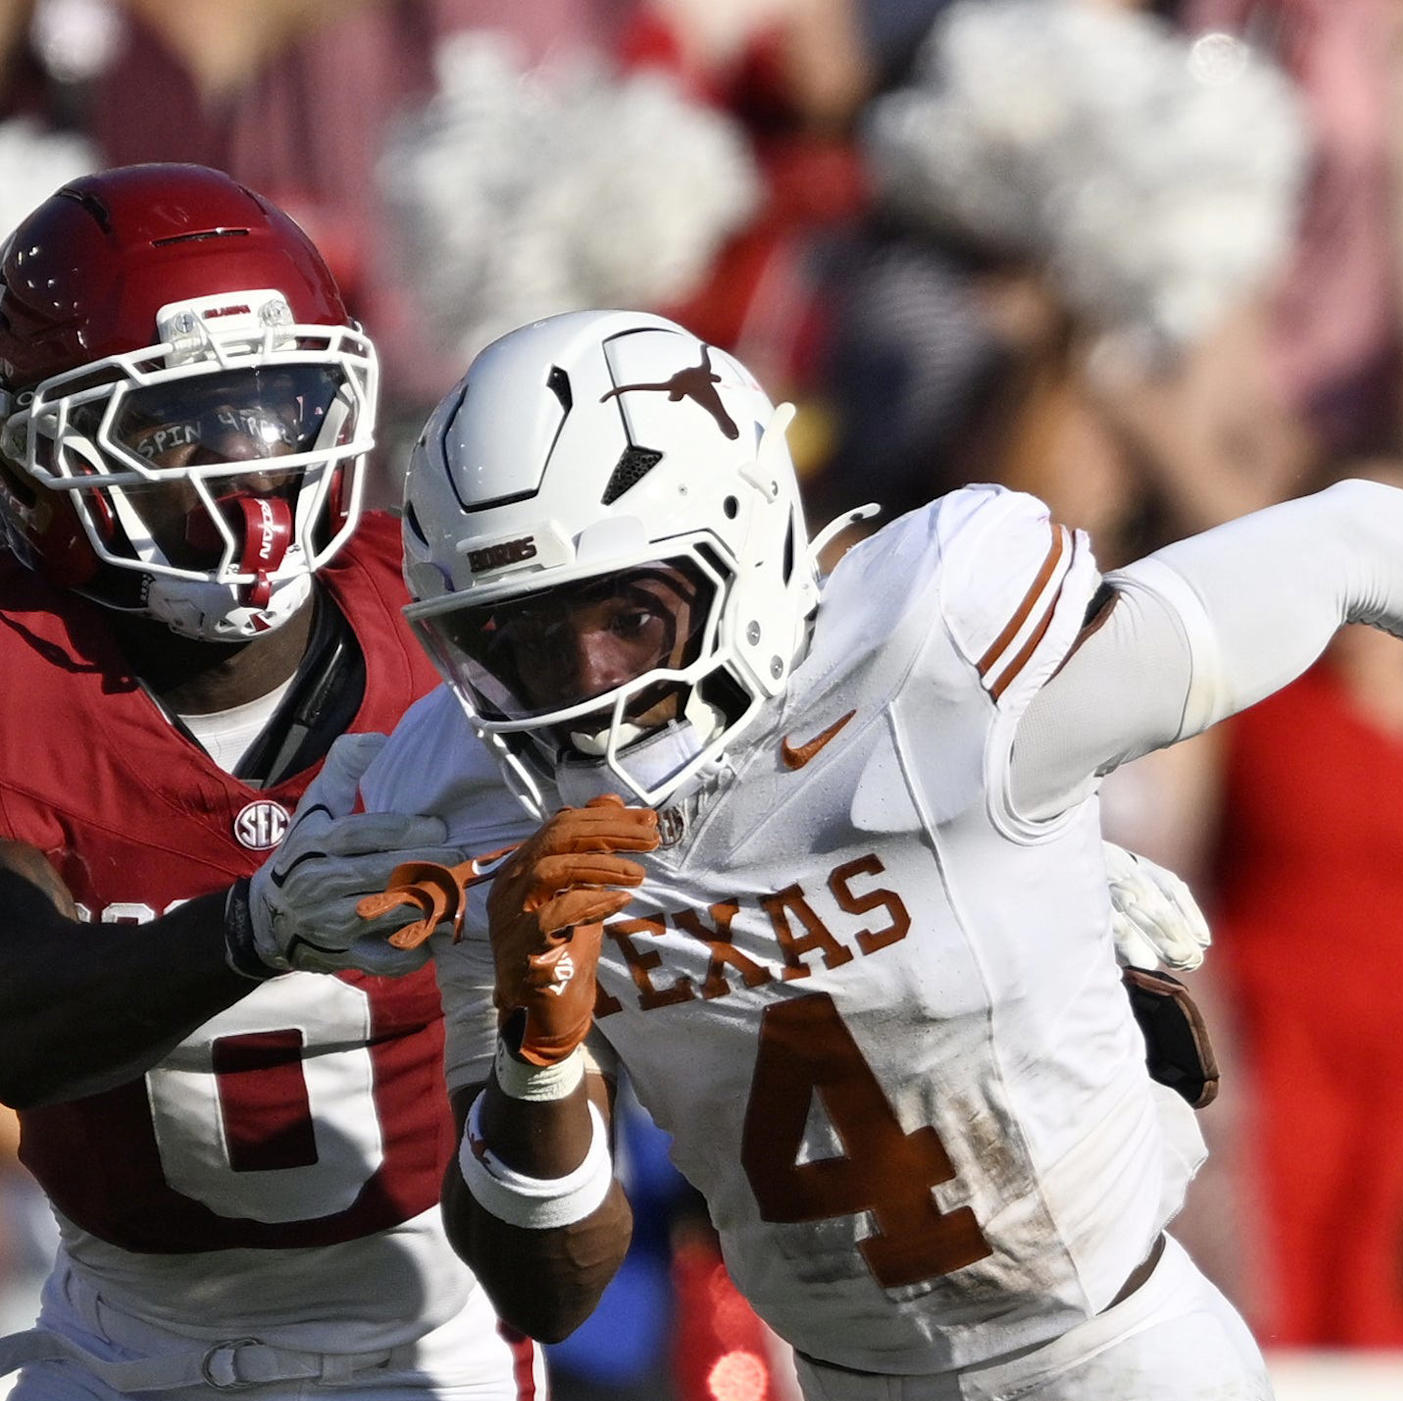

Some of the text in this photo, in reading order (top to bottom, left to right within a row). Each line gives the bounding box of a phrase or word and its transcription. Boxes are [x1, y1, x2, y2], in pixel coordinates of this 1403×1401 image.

[240, 803, 287, 847] SEC
[145, 970, 384, 1224] 0
[741, 991, 994, 1288] 4
